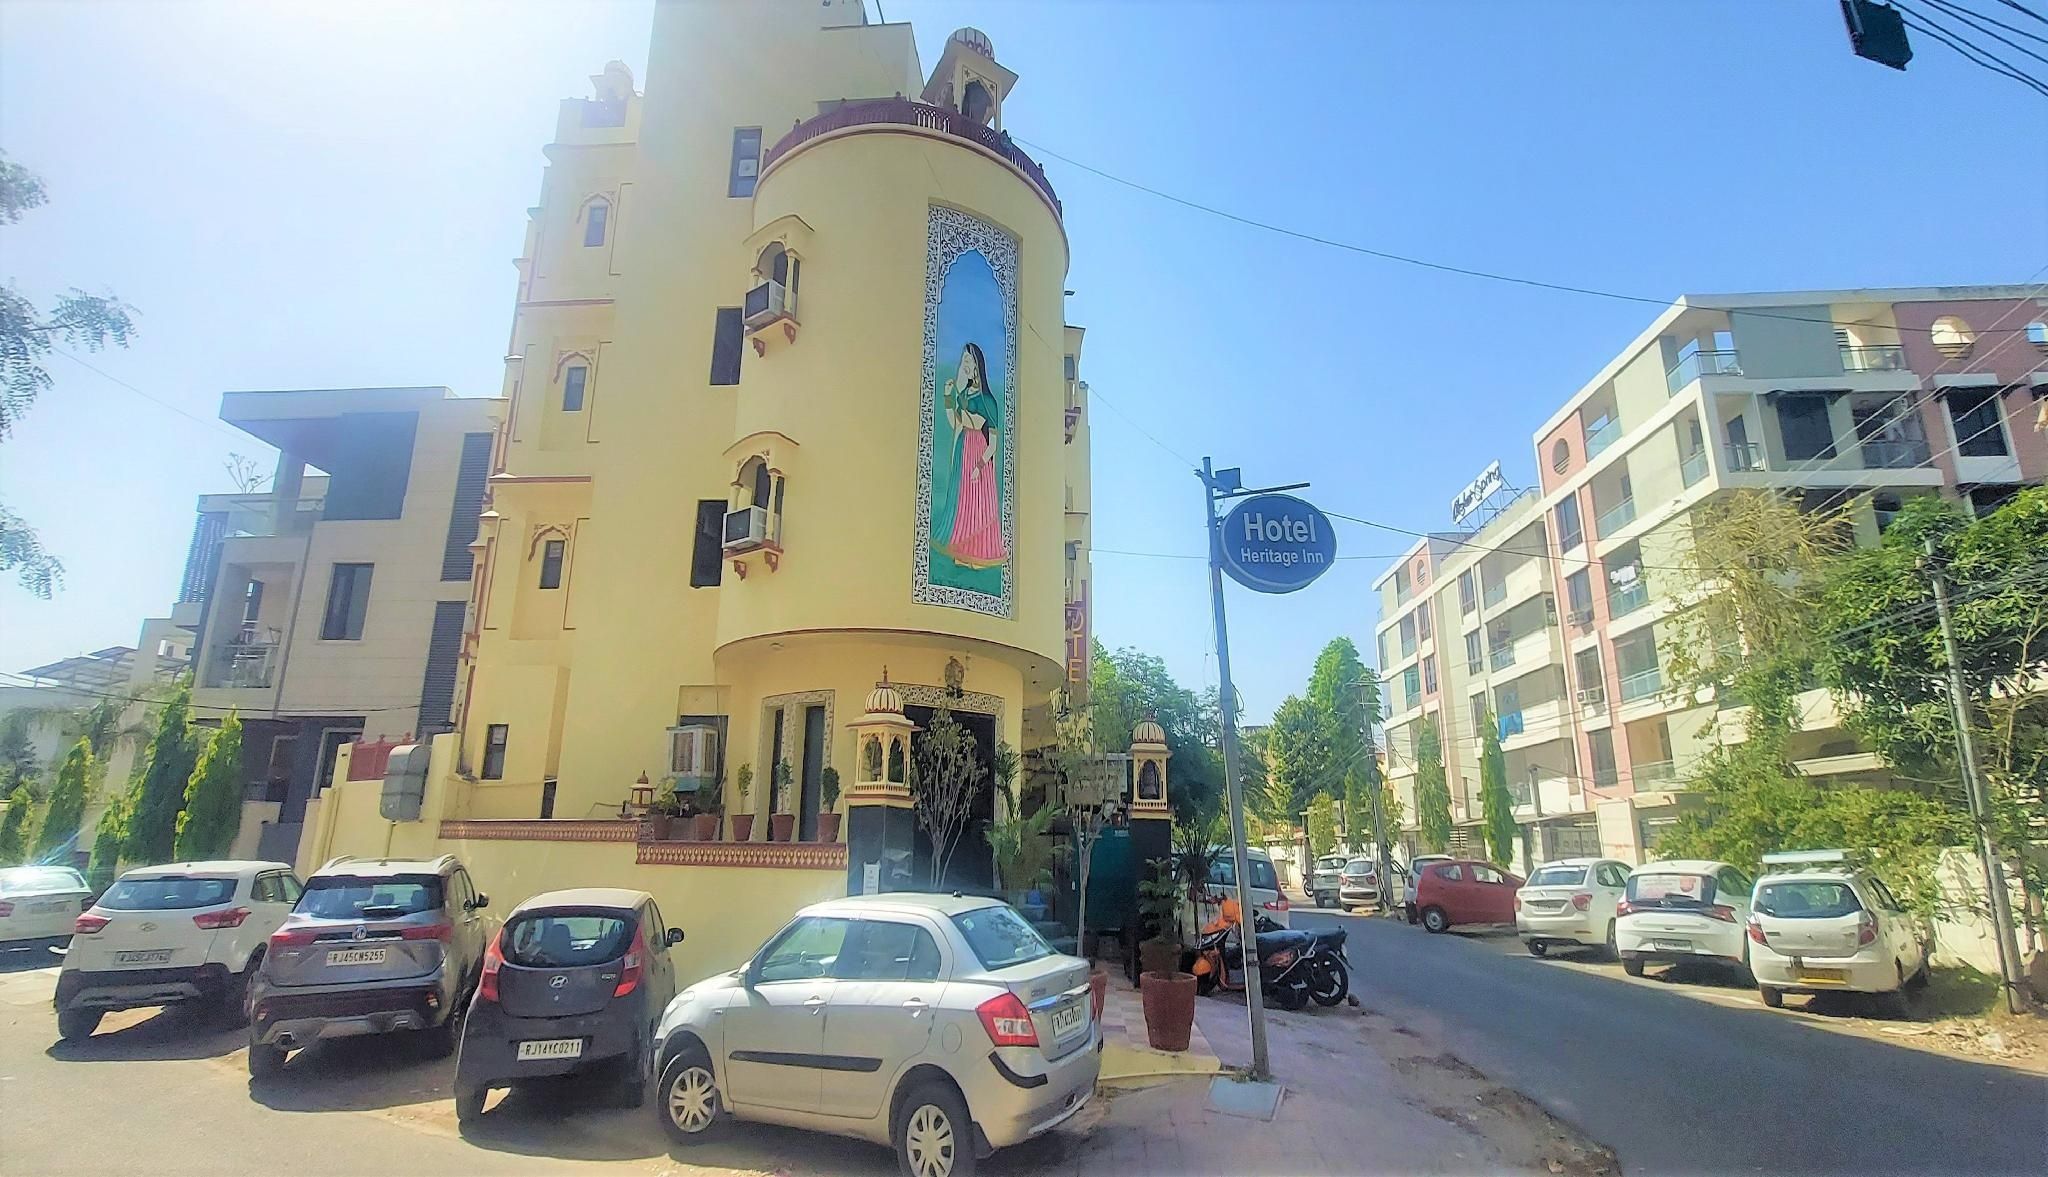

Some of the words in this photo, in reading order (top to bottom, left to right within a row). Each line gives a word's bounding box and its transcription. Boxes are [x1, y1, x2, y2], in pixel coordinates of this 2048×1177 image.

[1243, 512, 1317, 543] Hotel
[1240, 547, 1299, 567] Heritage
[1302, 548, 1325, 564] Inn
[525, 1041, 580, 1056] RJ14YC0211
